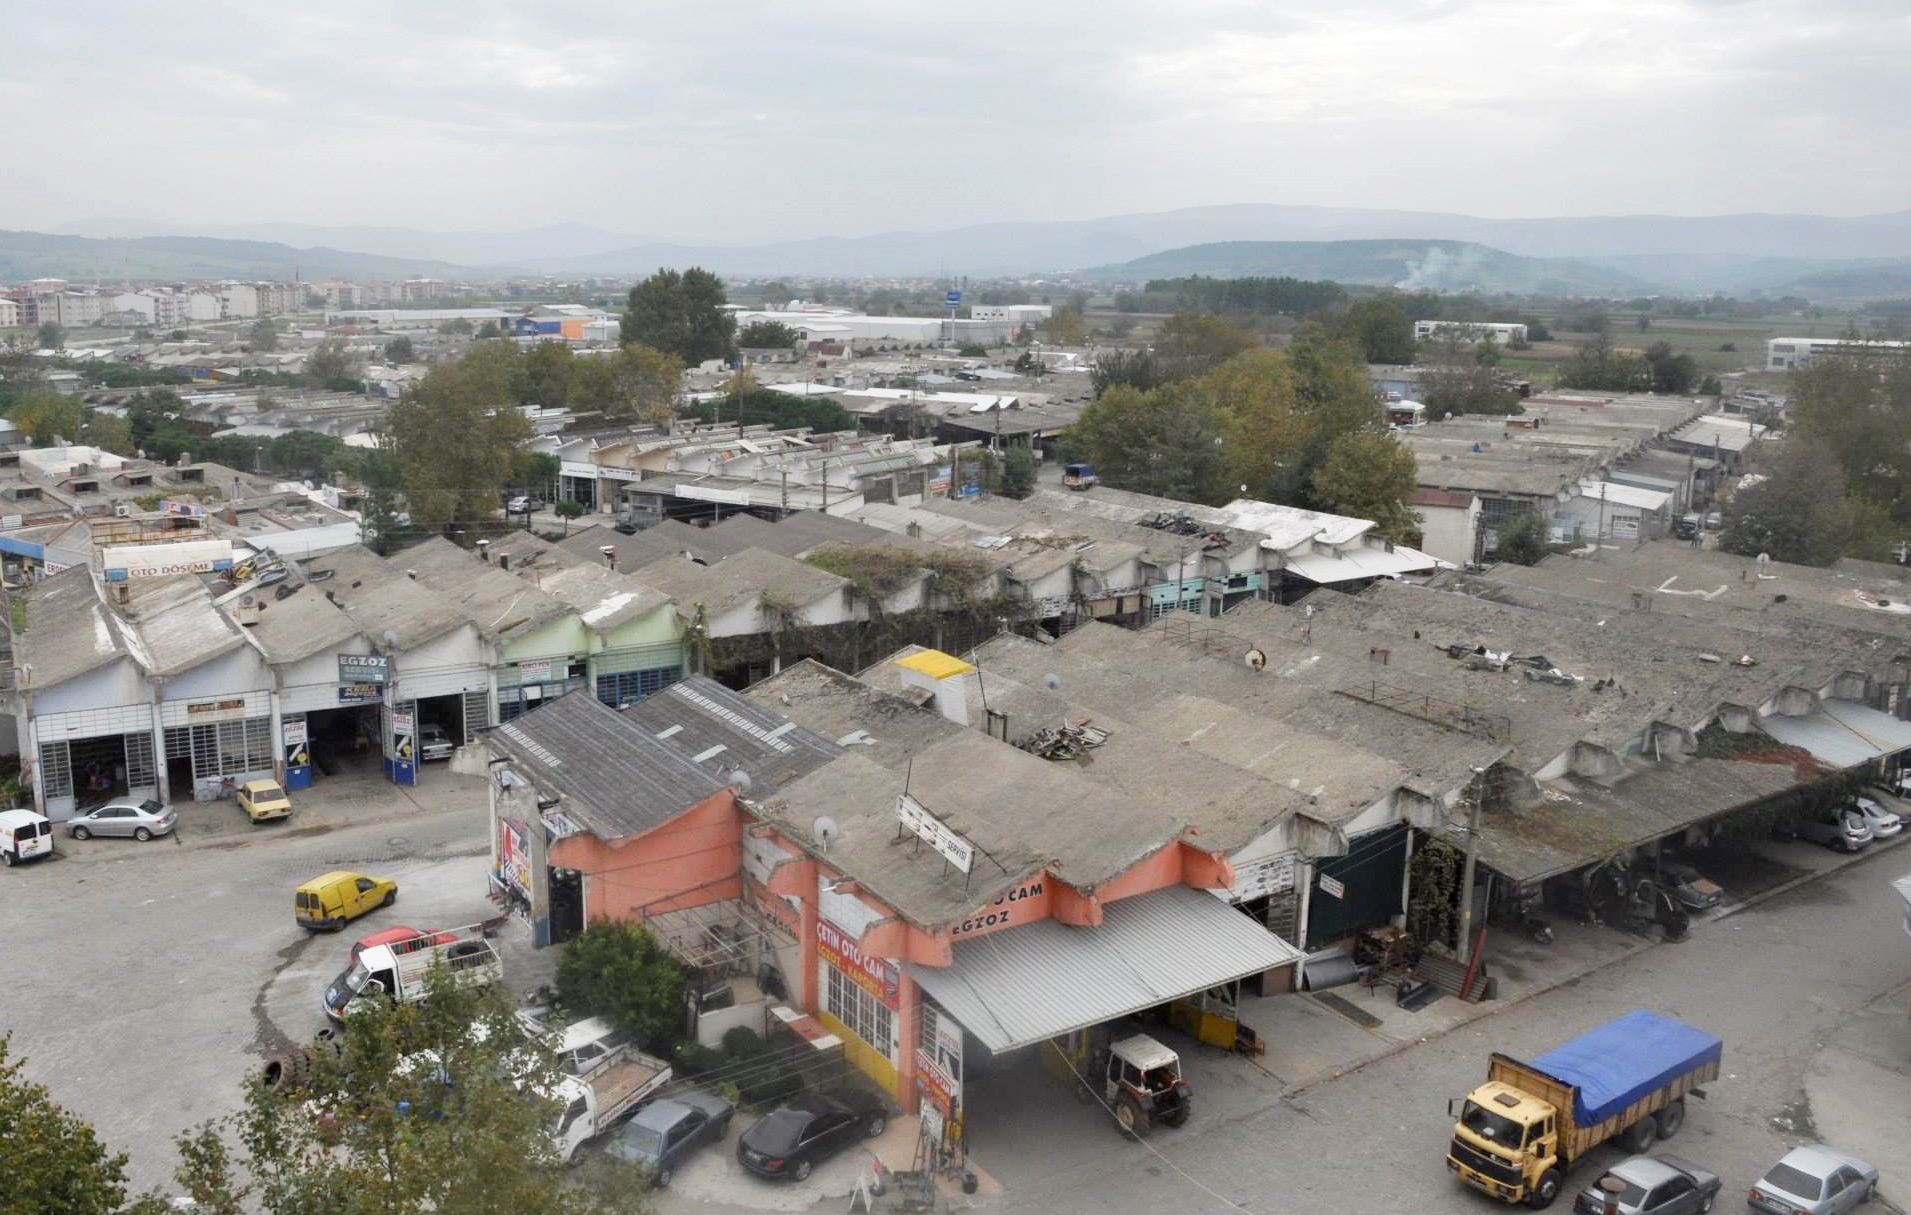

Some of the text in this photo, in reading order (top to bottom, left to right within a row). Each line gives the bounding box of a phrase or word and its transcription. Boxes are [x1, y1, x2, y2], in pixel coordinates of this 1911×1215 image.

[131, 567, 157, 577] OTO
[340, 656, 388, 667] EGZOZ
[1008, 882, 1043, 902] CAM
[816, 922, 840, 951] ÇETİN
[841, 939, 861, 966] OTO
[863, 955, 885, 983] CAM
